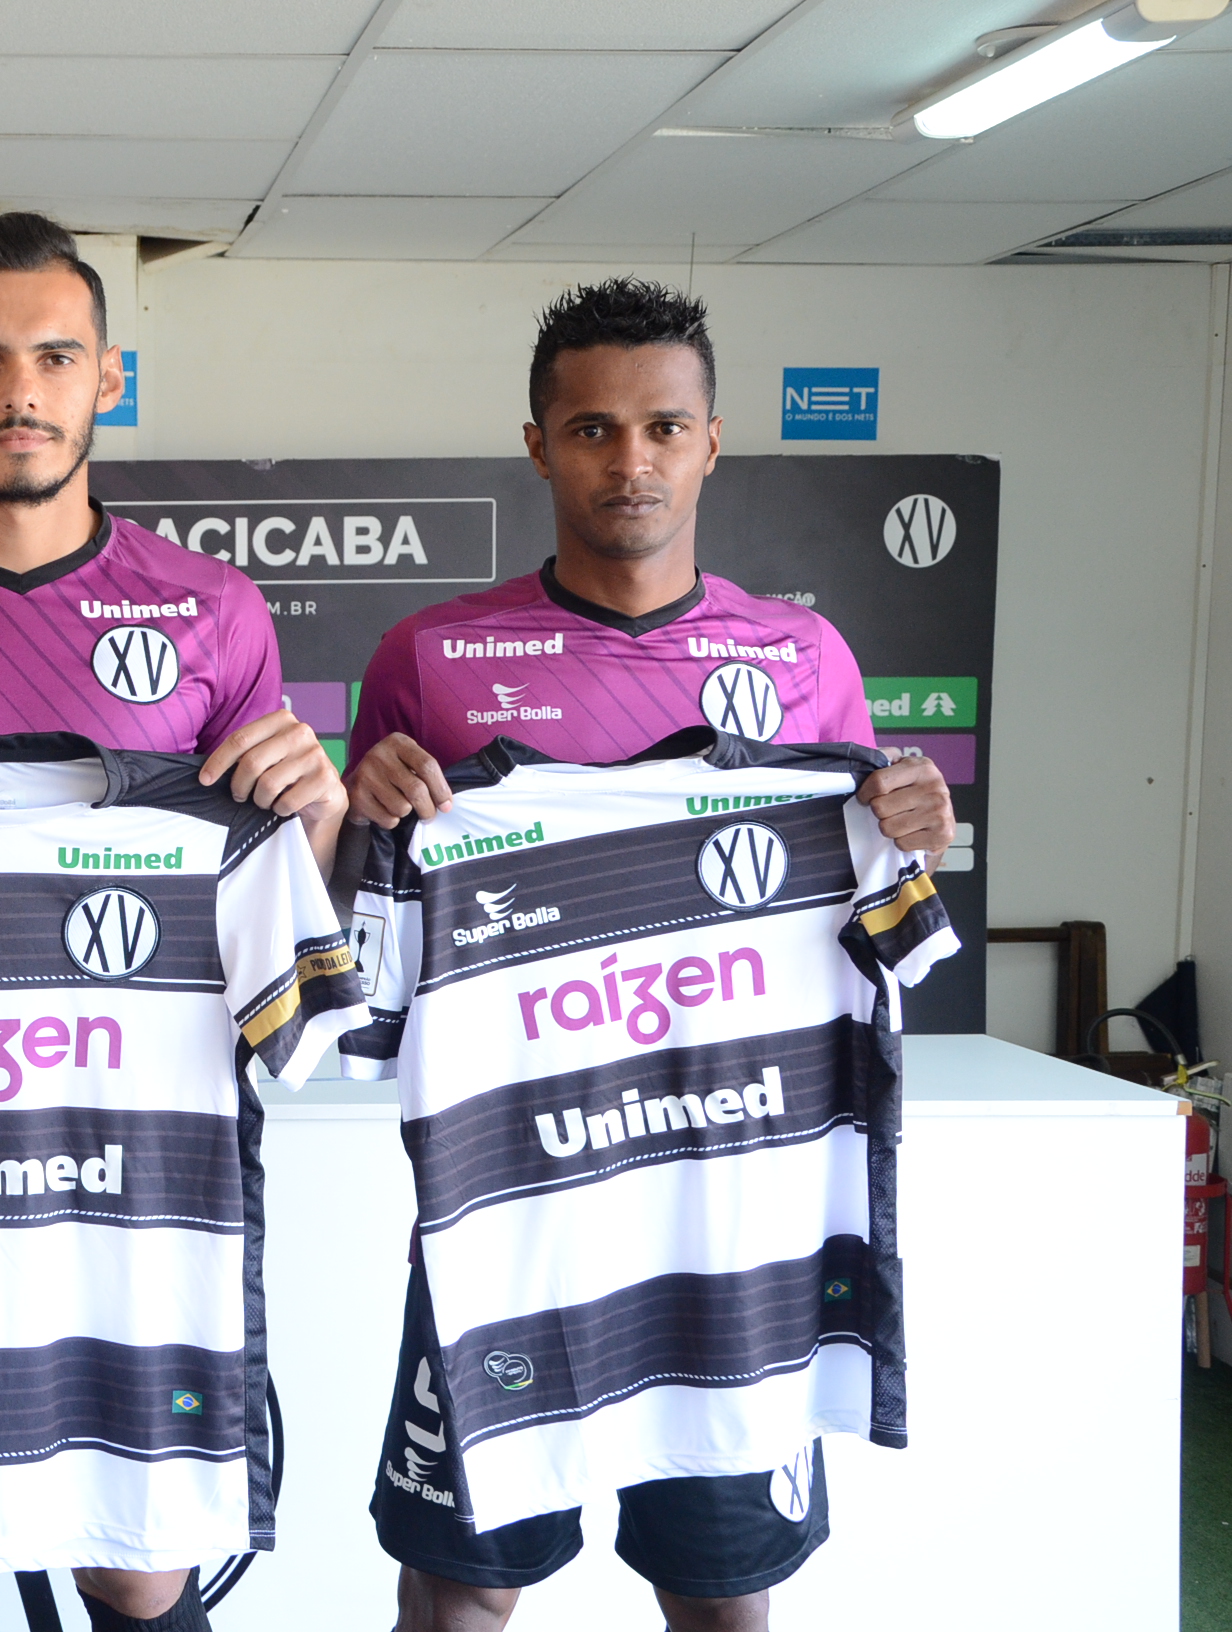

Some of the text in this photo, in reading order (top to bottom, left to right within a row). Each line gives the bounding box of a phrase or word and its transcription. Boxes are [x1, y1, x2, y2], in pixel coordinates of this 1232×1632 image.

[786, 387, 875, 410] NET
[124, 517, 429, 566] CICABA
[895, 497, 947, 565] XV
[80, 597, 199, 619] Unimed
[107, 630, 168, 697] XV
[442, 633, 564, 659] Unimed
[687, 637, 798, 664] Unimed
[466, 705, 563, 725] Super Bolla
[716, 667, 770, 741] XV
[57, 846, 185, 870] Unimed
[421, 822, 545, 867] Unimed
[712, 827, 774, 904] XV
[81, 893, 146, 973] XV
[452, 906, 561, 947] Super Bolla
[517, 946, 767, 1046] raízen
[535, 1065, 785, 1159] Unimed
[385, 1459, 421, 1494] Super
